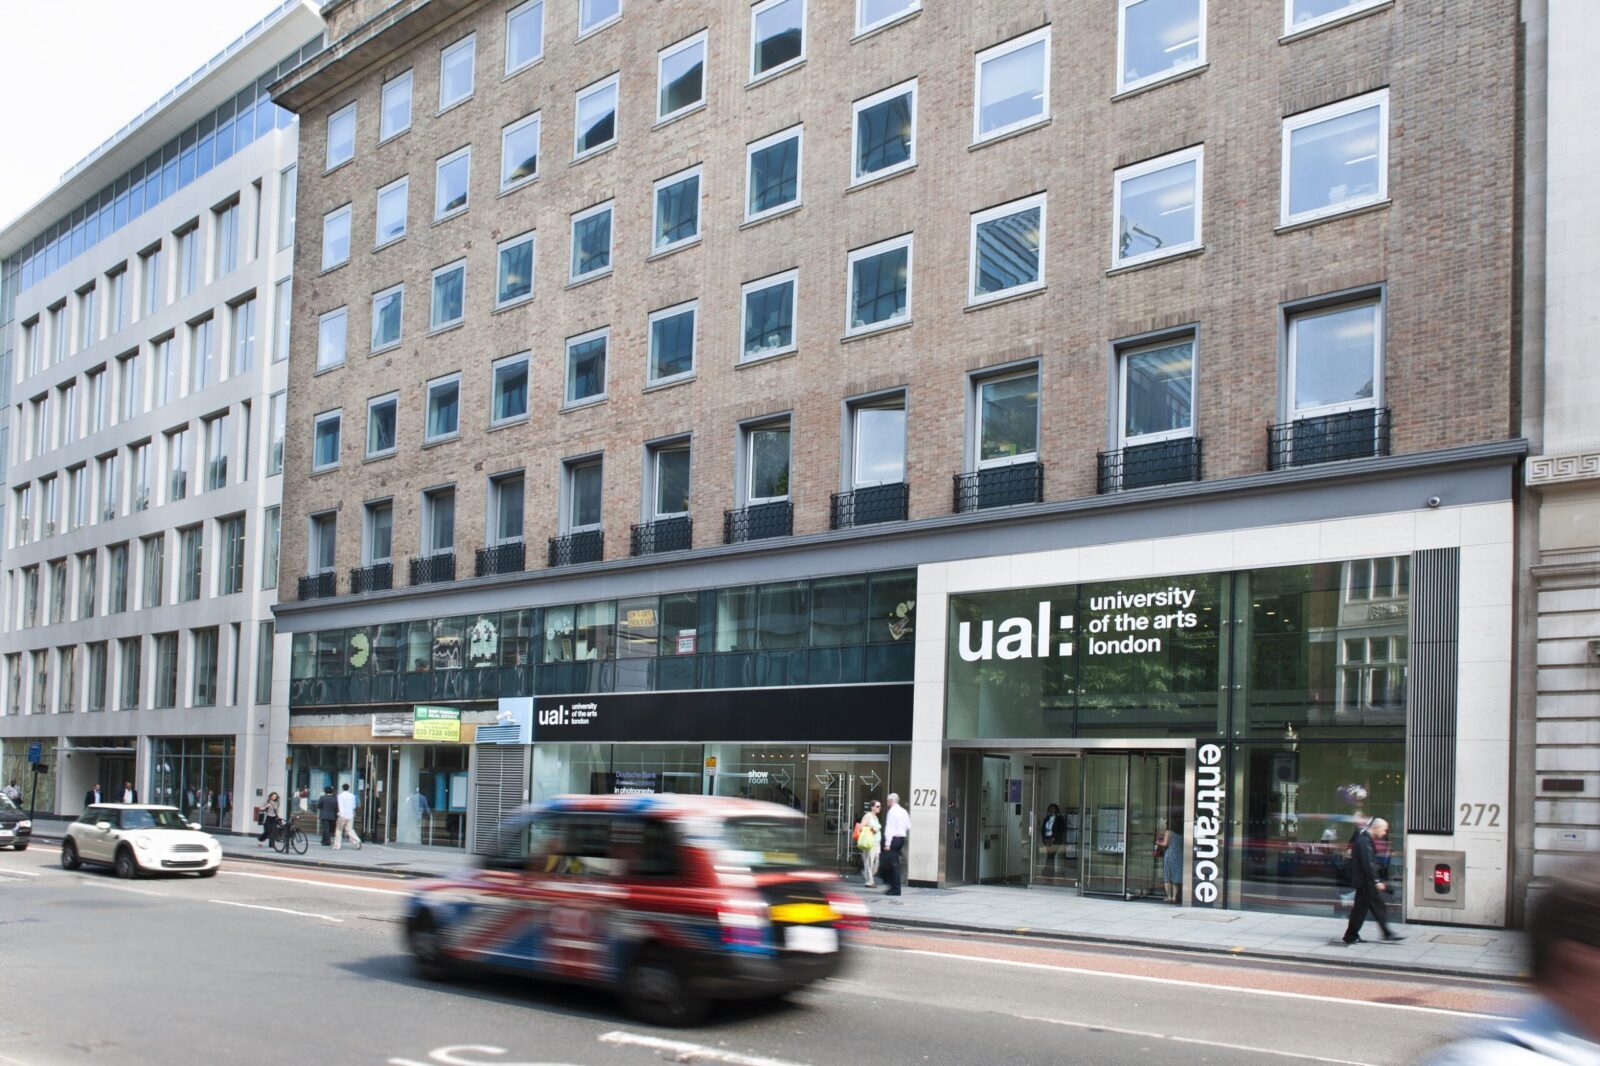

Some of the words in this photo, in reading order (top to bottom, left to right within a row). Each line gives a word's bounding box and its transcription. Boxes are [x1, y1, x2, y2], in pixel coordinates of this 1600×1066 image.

[1090, 587, 1196, 611] university
[958, 601, 1073, 662] ual:
[1089, 616, 1110, 633] of
[1115, 614, 1151, 632] the
[1153, 610, 1197, 630] arts
[1089, 635, 1161, 655] london
[539, 704, 569, 725] ual:
[571, 717, 590, 725] london
[748, 769, 769, 778] show
[913, 788, 937, 807] 272
[1194, 743, 1226, 903] entrance
[1460, 803, 1501, 827] 272
